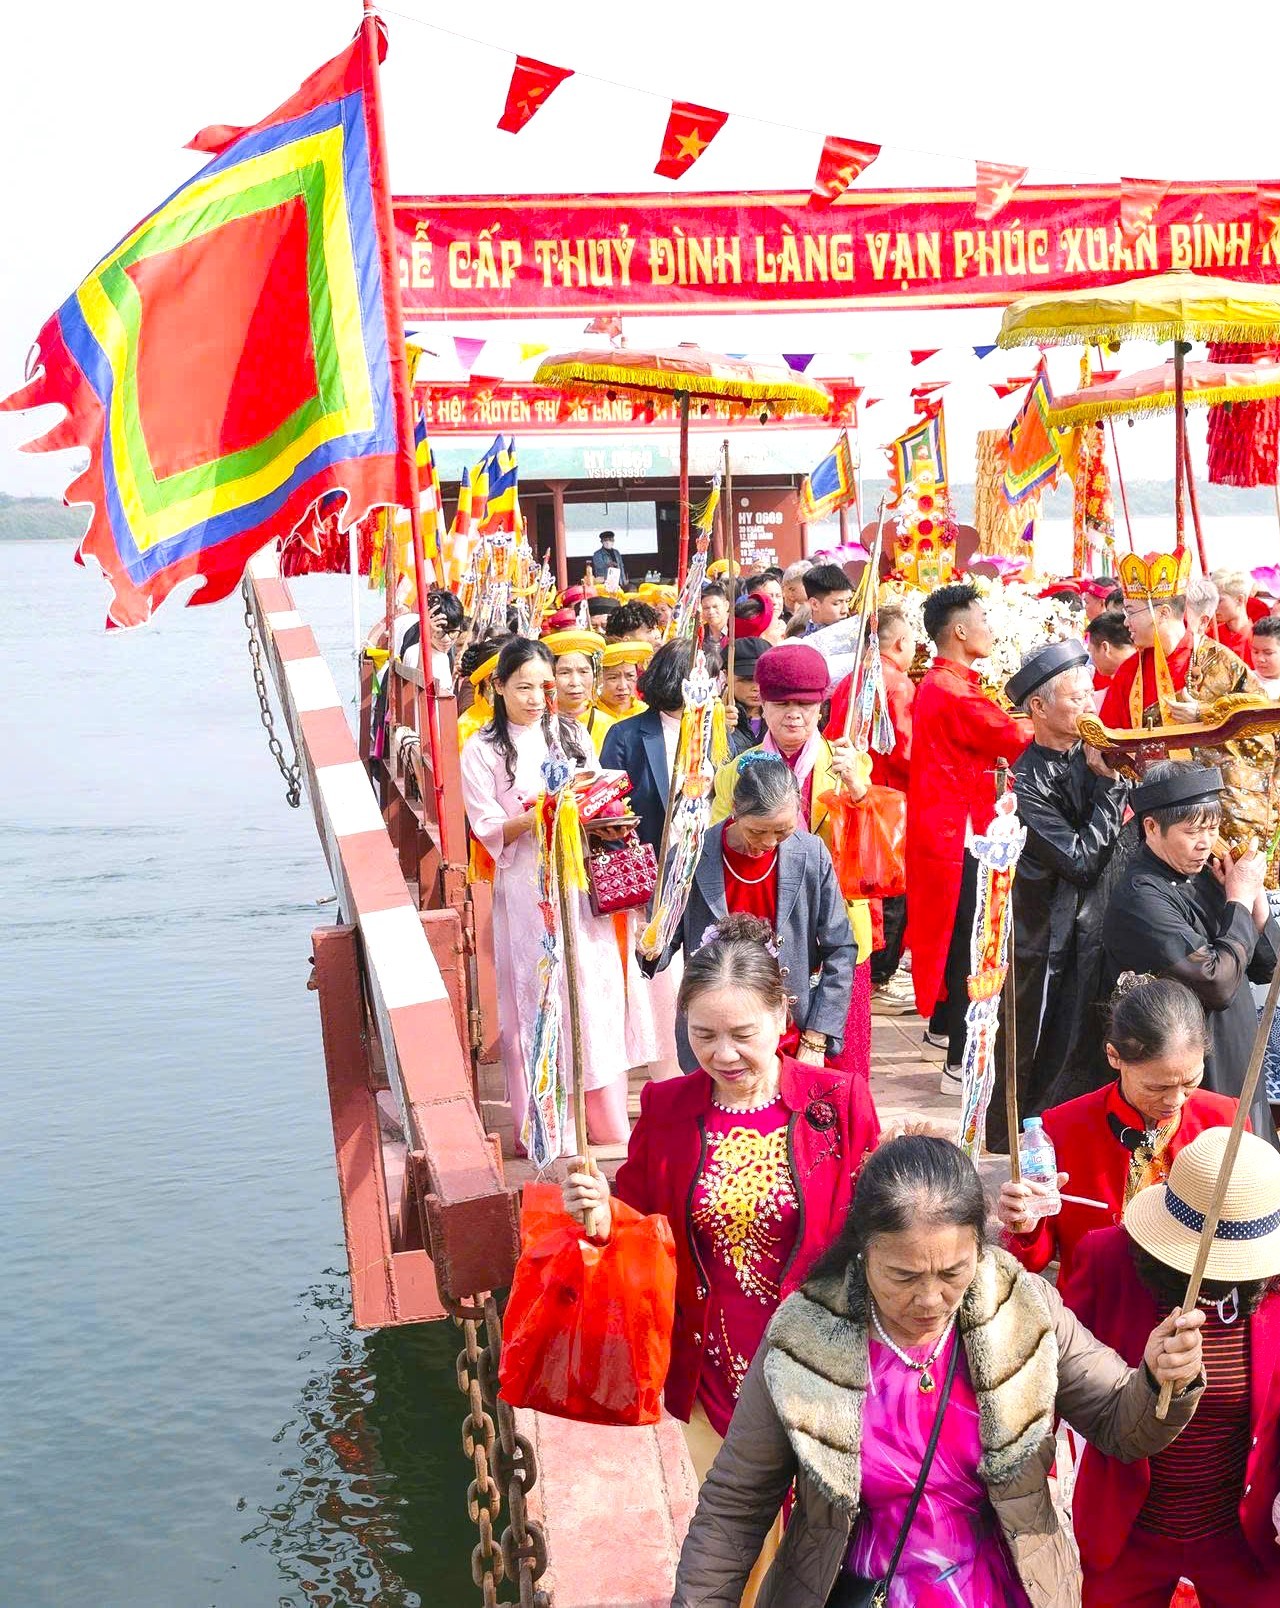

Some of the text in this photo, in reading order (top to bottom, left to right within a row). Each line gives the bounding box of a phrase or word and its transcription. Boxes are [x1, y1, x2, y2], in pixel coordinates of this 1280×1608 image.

[449, 222, 522, 288] CẤP
[536, 224, 635, 287] THUỶ
[649, 226, 740, 284] ĐÌNH
[756, 225, 853, 282] LÀNG
[866, 233, 940, 290] VẠN
[954, 219, 1049, 277] PHÚC
[1170, 212, 1250, 269] BÍNH
[738, 512, 753, 525] HY
